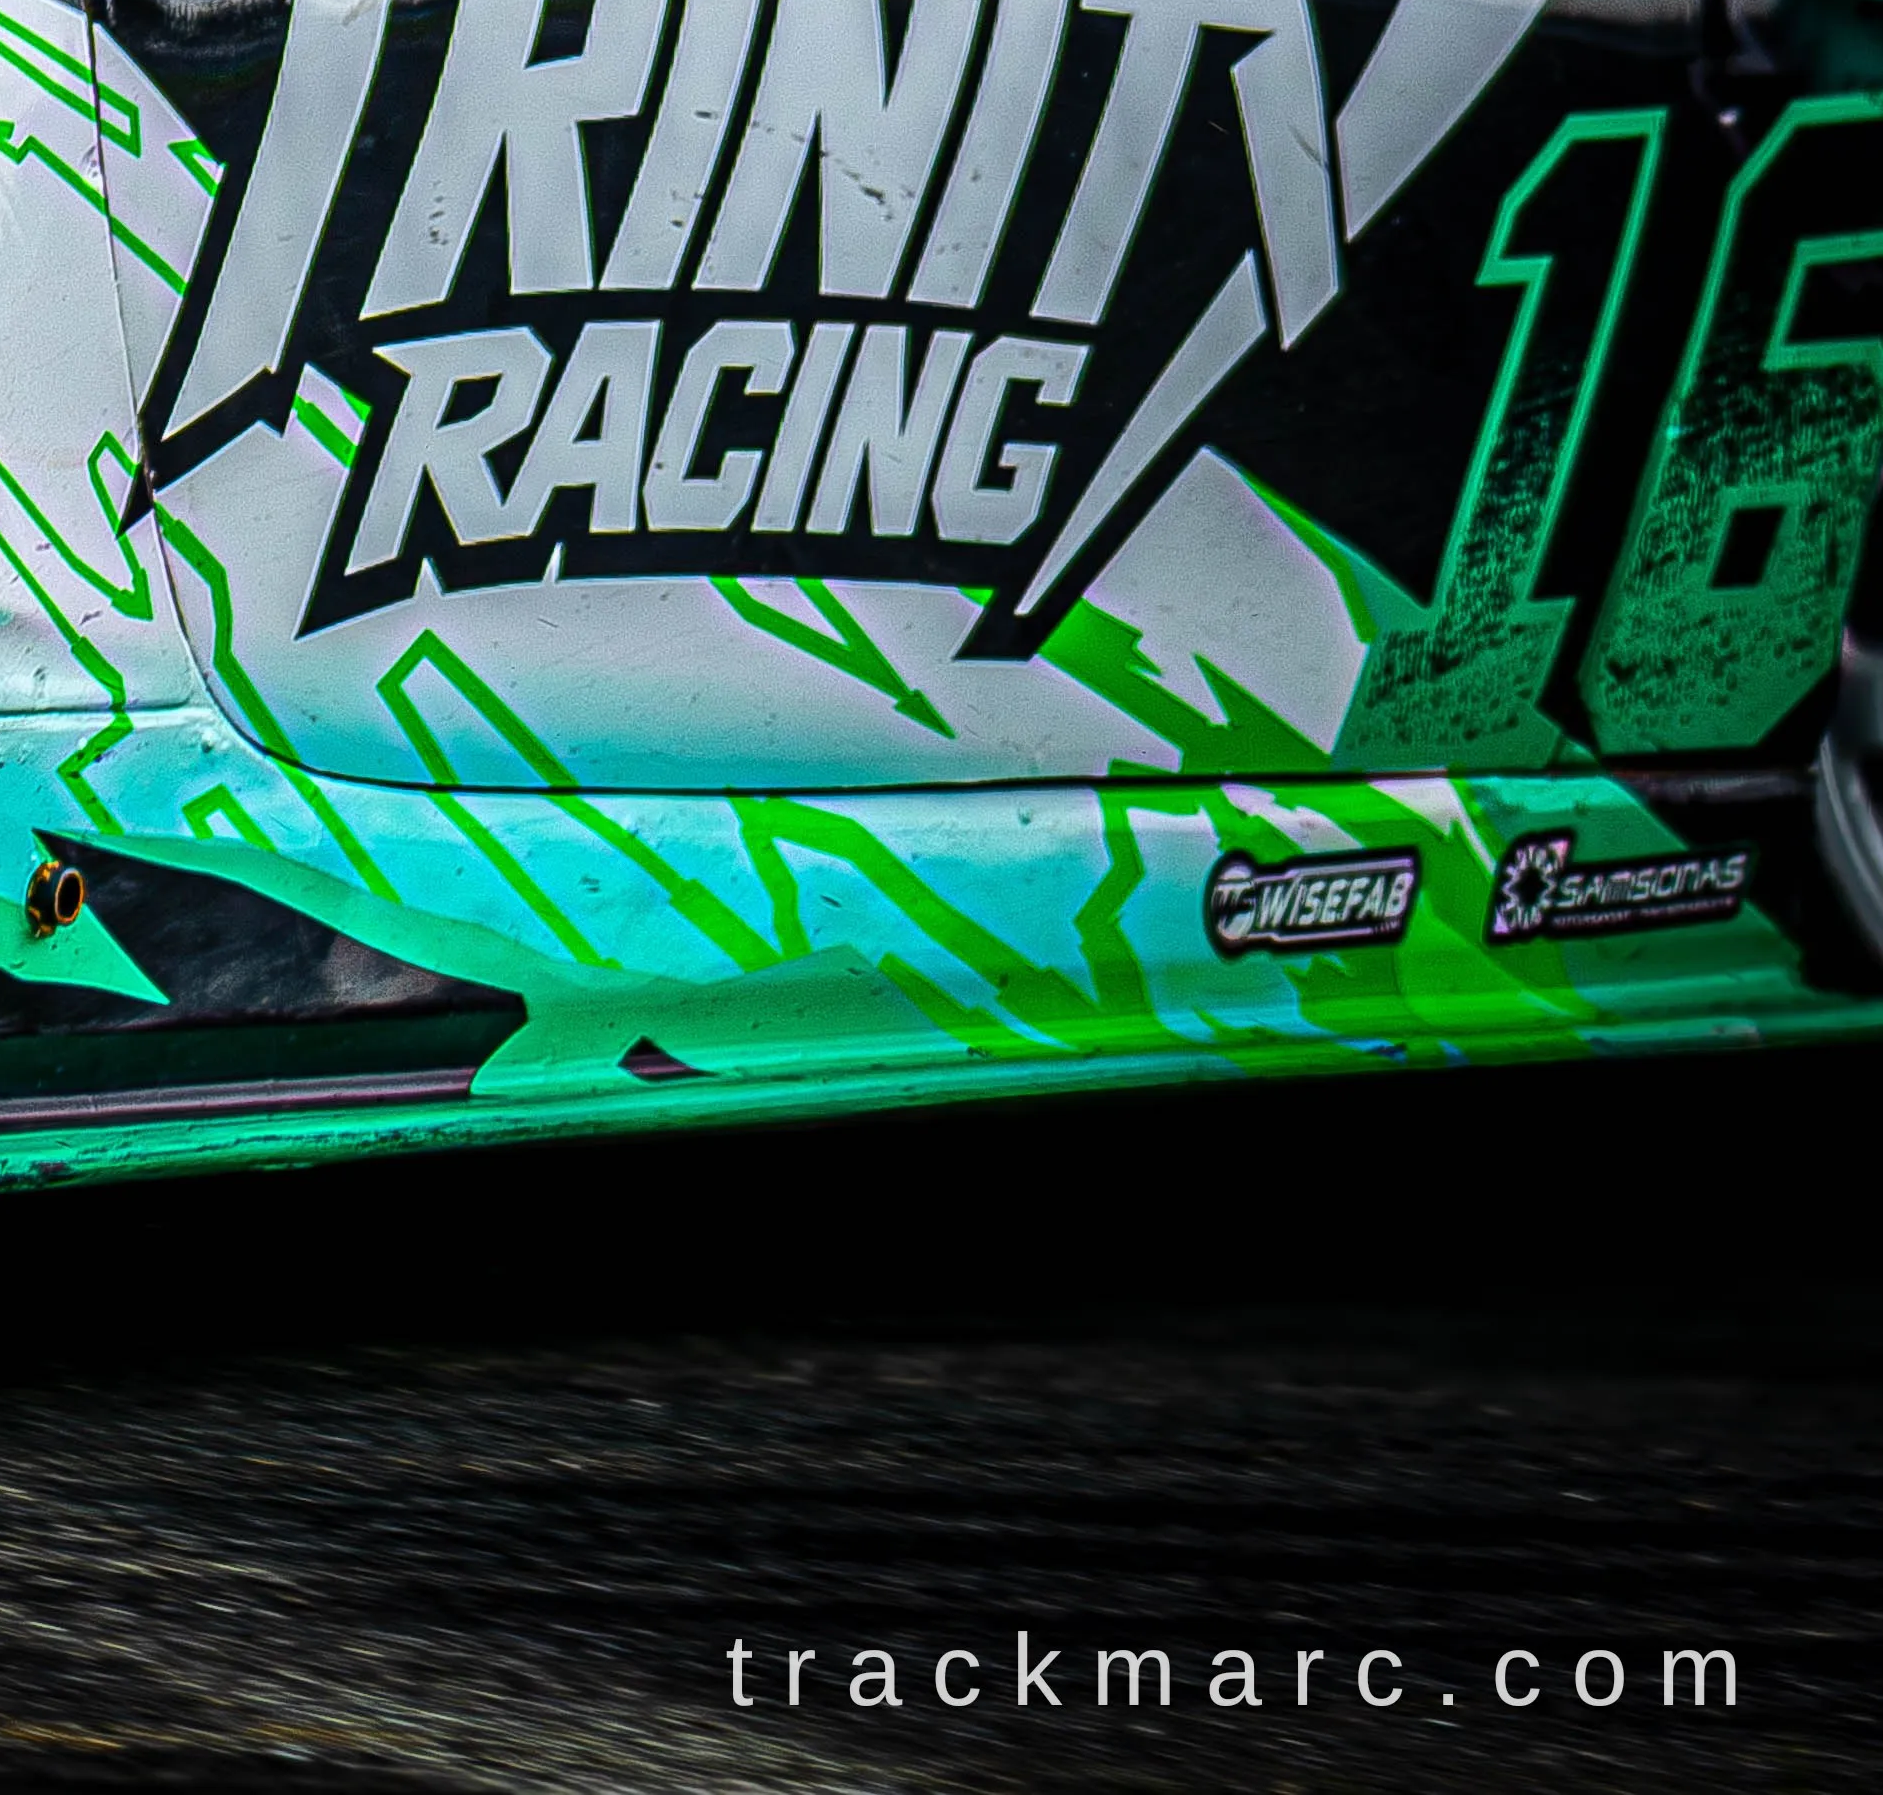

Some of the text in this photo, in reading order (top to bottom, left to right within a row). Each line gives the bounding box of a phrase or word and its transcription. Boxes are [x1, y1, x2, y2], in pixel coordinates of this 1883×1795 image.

[344, 319, 1091, 578] RACING
[1332, 92, 1883, 768] 16
[1258, 871, 1415, 930] WISEFAB
